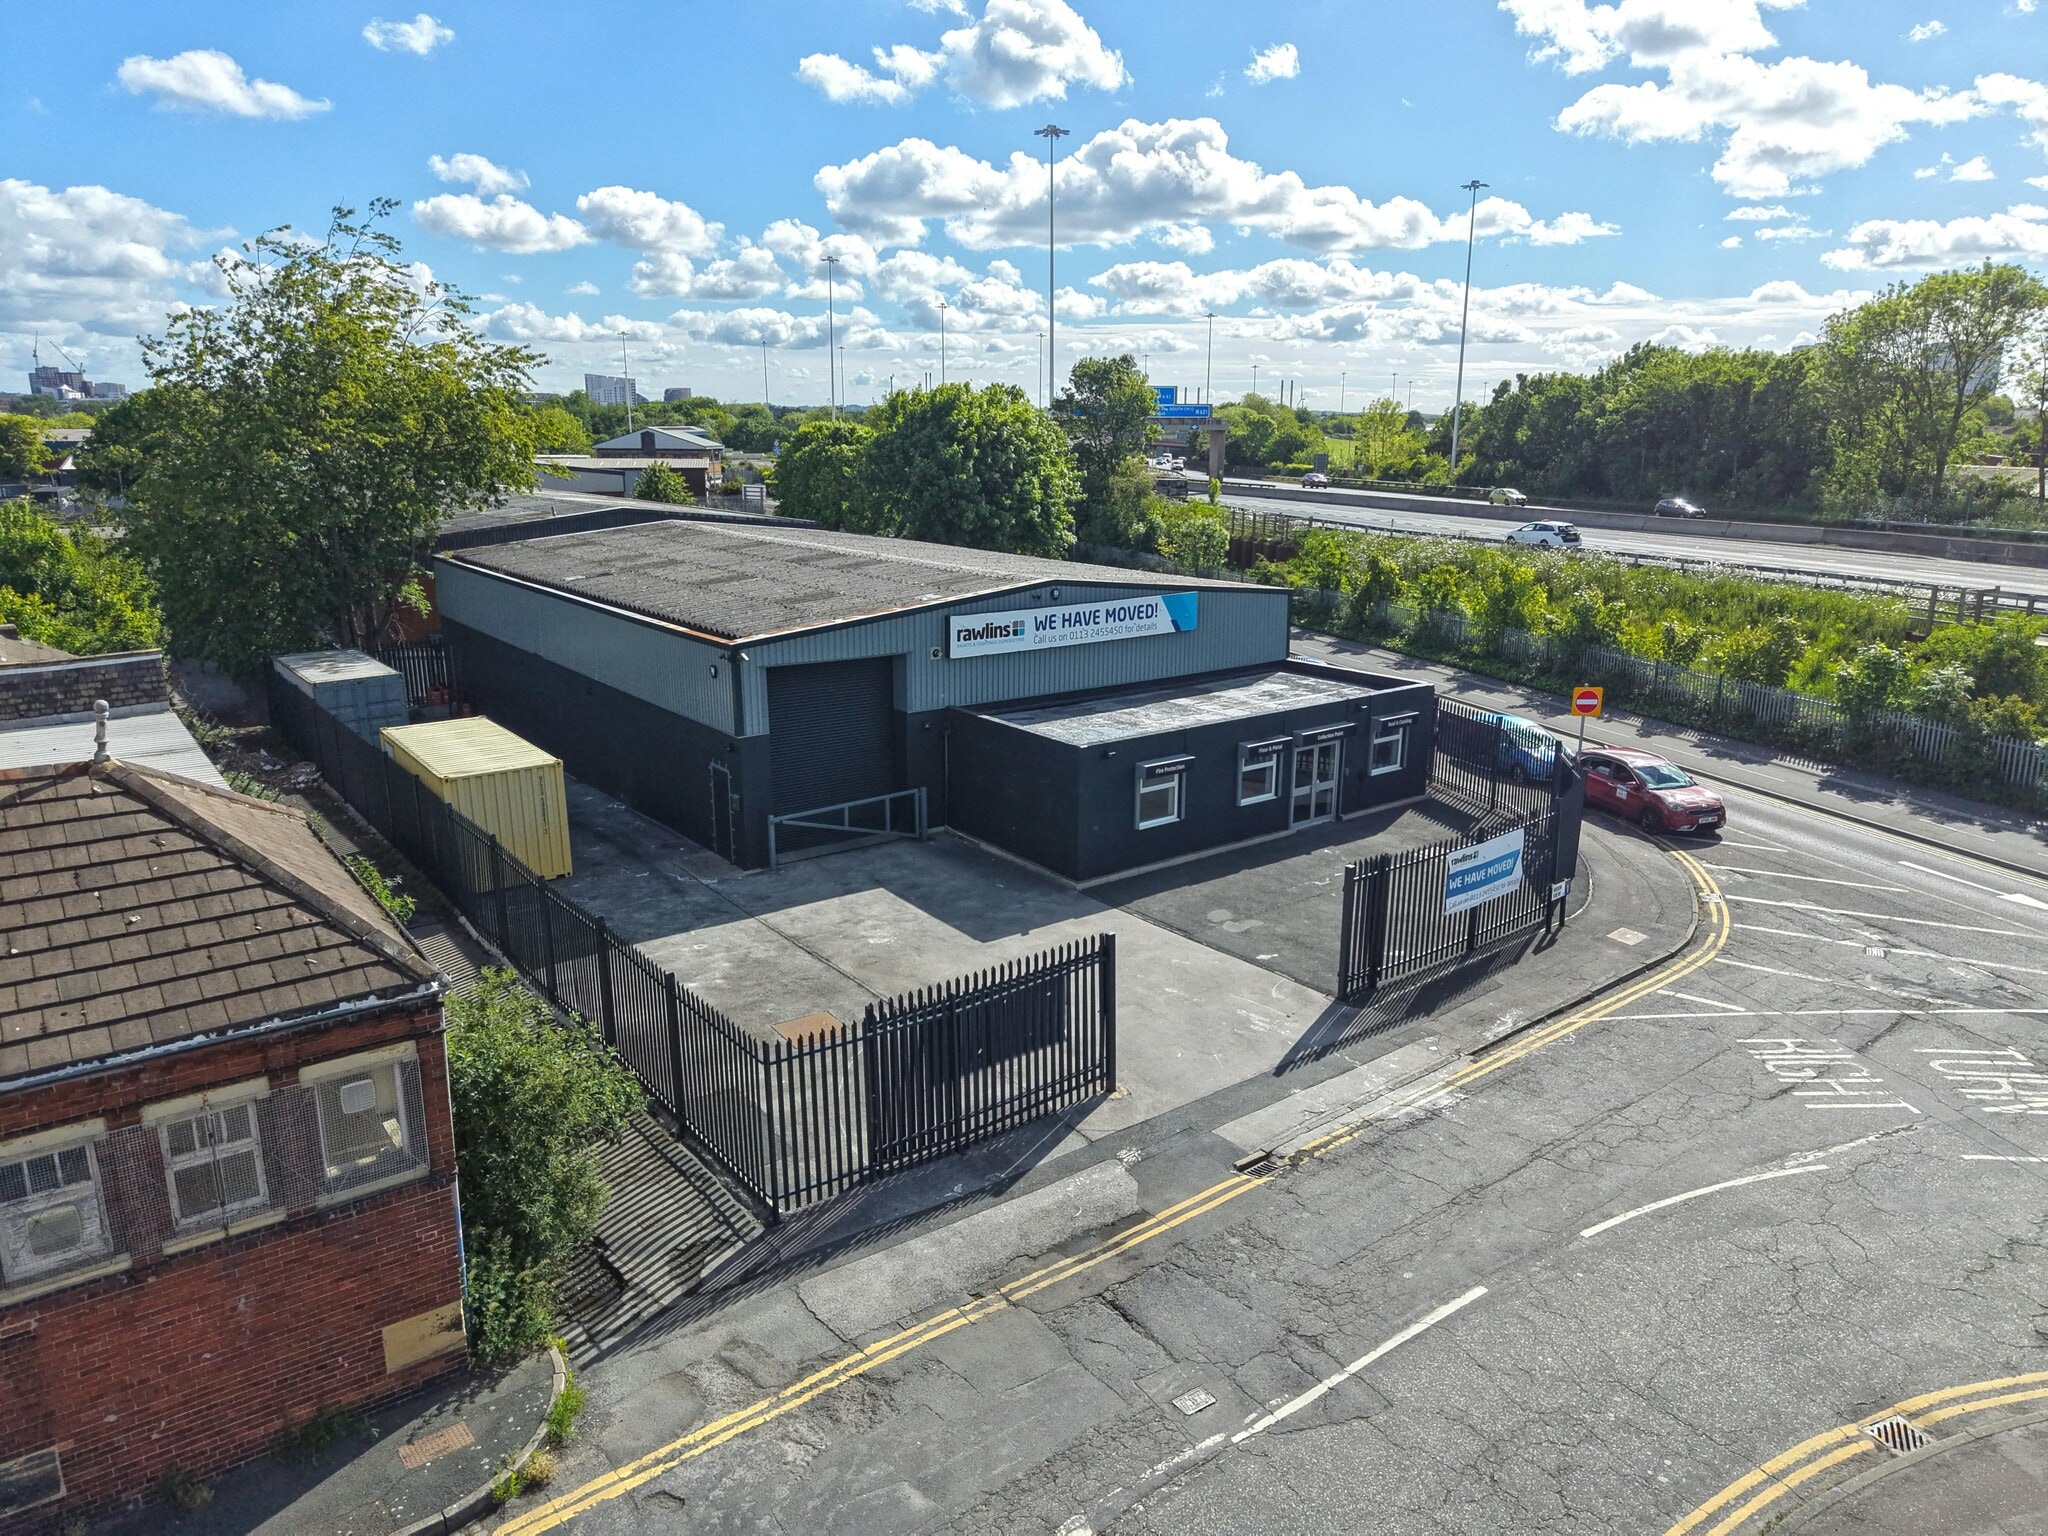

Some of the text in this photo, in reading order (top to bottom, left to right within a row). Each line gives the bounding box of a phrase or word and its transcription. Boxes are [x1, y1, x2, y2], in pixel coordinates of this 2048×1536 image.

[1034, 602, 1159, 632] WE HAVE MOVED!
[957, 622, 1011, 642] rawlins
[1033, 621, 1158, 645] Call us on 0113 2455450 for details
[1317, 733, 1334, 741] Collection
[1164, 764, 1186, 773] Protection
[1451, 852, 1473, 866] rawlins
[1449, 876, 1463, 890] WE
[1464, 868, 1487, 885] HAVE
[1487, 857, 1515, 878] MOVED!
[1736, 1038, 1922, 1114] RIGHT
